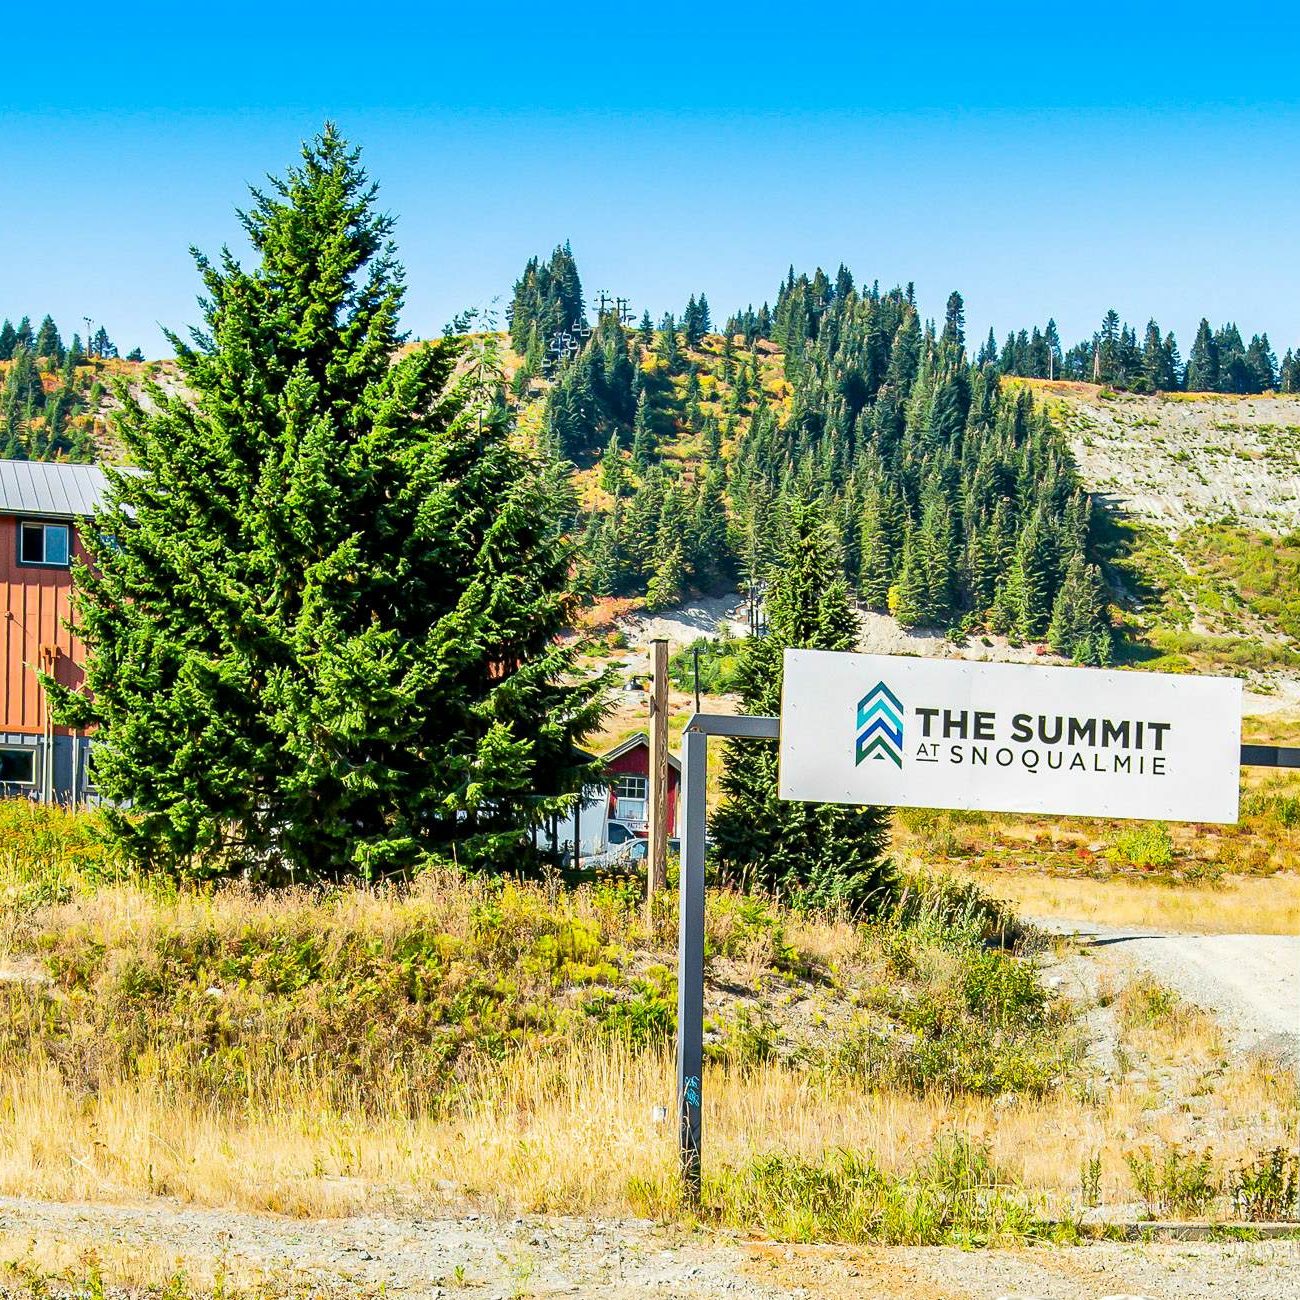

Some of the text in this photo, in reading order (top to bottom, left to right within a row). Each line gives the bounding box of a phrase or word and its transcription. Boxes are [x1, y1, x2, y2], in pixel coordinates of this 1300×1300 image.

[915, 707, 1171, 751] THE SUMMIT
[916, 743, 1166, 775] AT SNOQUALMIE
